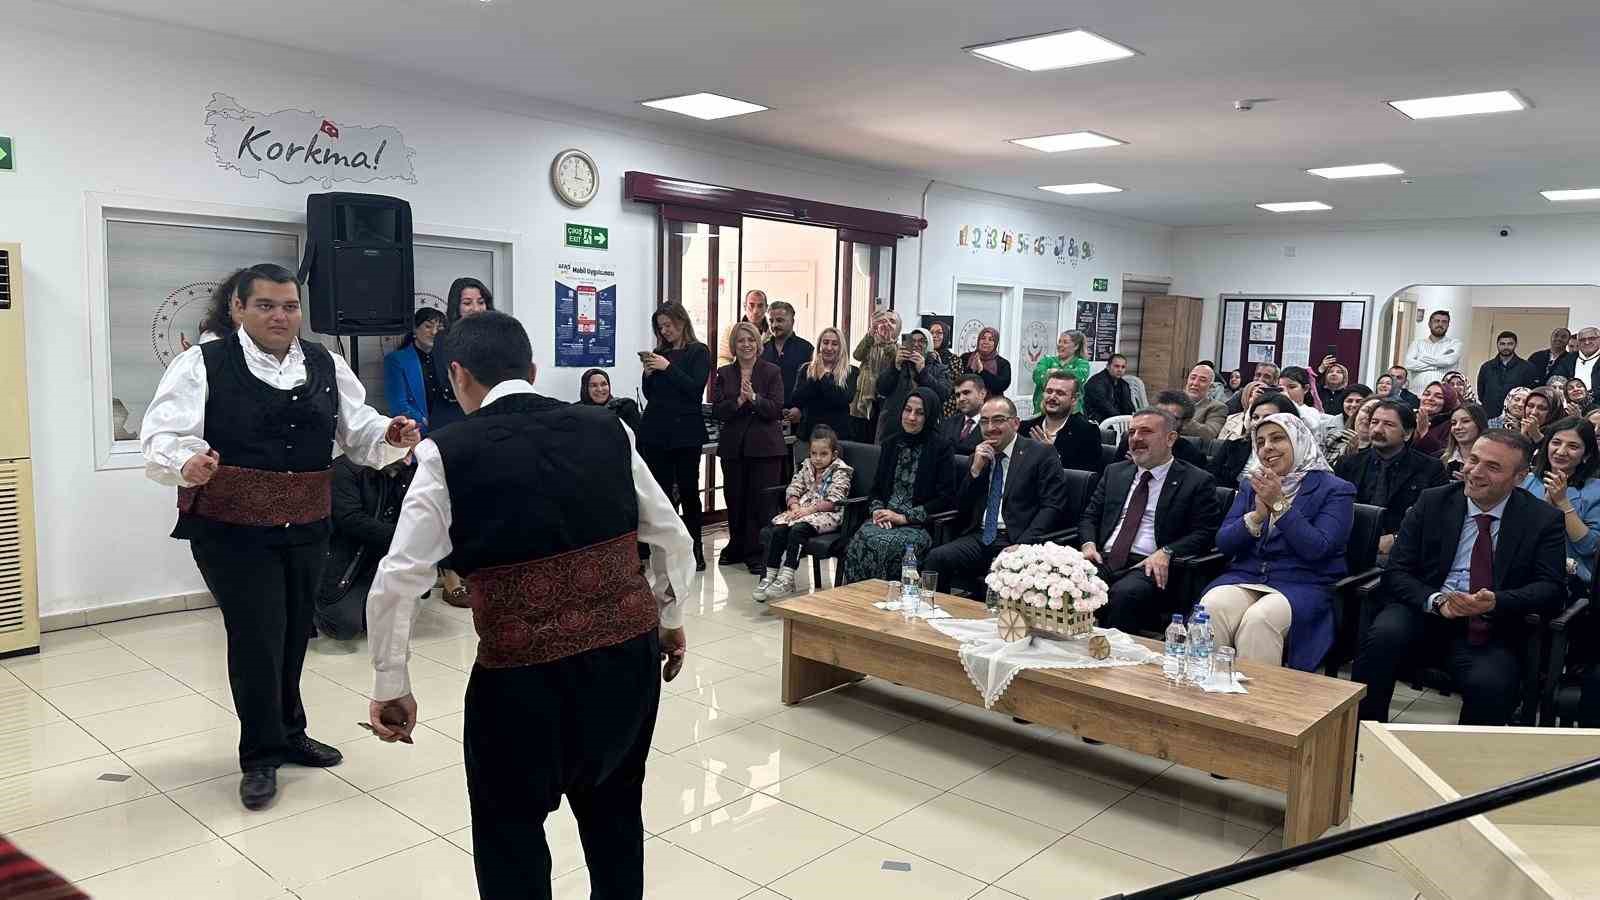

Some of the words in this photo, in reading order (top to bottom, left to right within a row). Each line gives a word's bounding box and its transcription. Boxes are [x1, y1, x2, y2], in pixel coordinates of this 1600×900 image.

[238, 125, 387, 170] Korkma!
[568, 235, 581, 243] EXIT
[972, 228, 981, 248] 2
[1017, 233, 1024, 253] 5
[1068, 238, 1075, 256] 8
